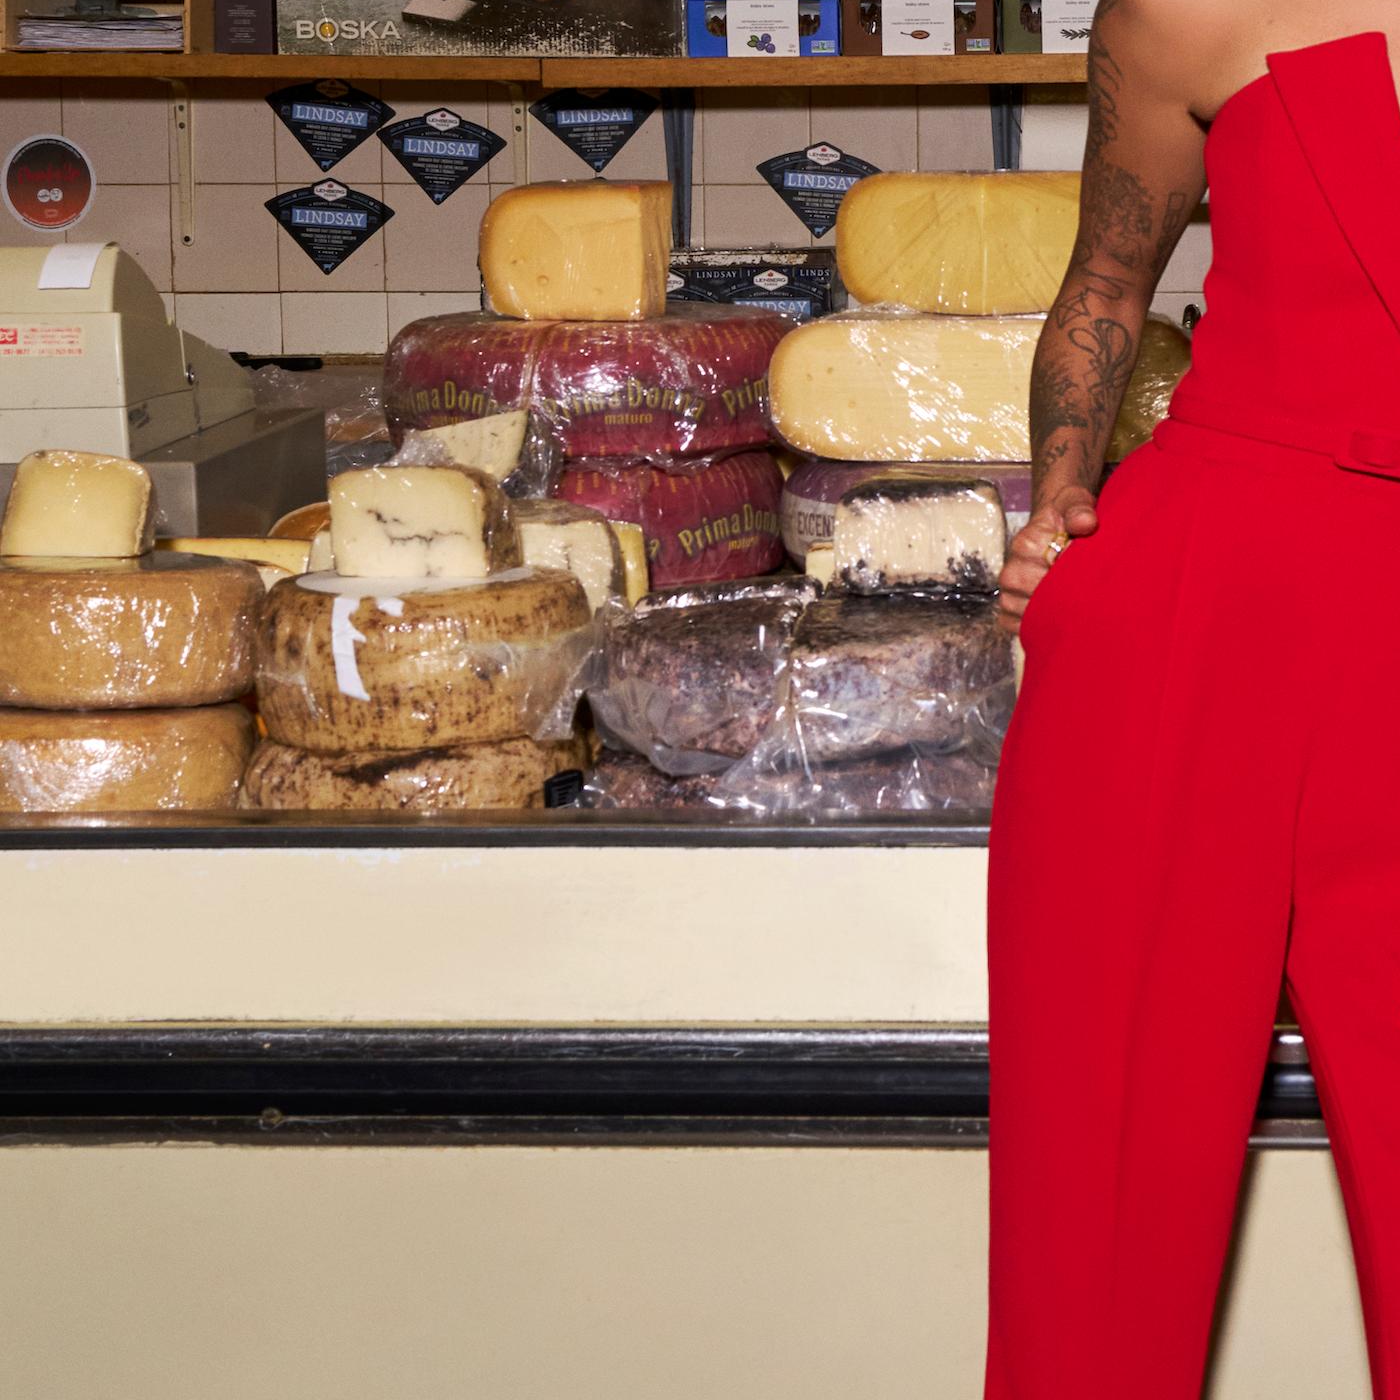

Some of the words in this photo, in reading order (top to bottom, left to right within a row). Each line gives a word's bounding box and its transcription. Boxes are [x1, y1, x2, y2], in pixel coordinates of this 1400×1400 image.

[295, 18, 402, 41] BOSKA
[294, 105, 366, 126] LINDSAY
[559, 110, 630, 124] LINDSAY
[407, 139, 477, 157] LINDSAY
[787, 173, 857, 191] LINDSAY
[294, 209, 366, 227] LINDSAY
[696, 270, 738, 280] LINDSAY
[735, 301, 808, 319] NDSAY
[627, 379, 706, 422] Donna
[721, 377, 767, 416] Prim
[603, 412, 654, 426] maturo
[678, 511, 740, 557] Prima
